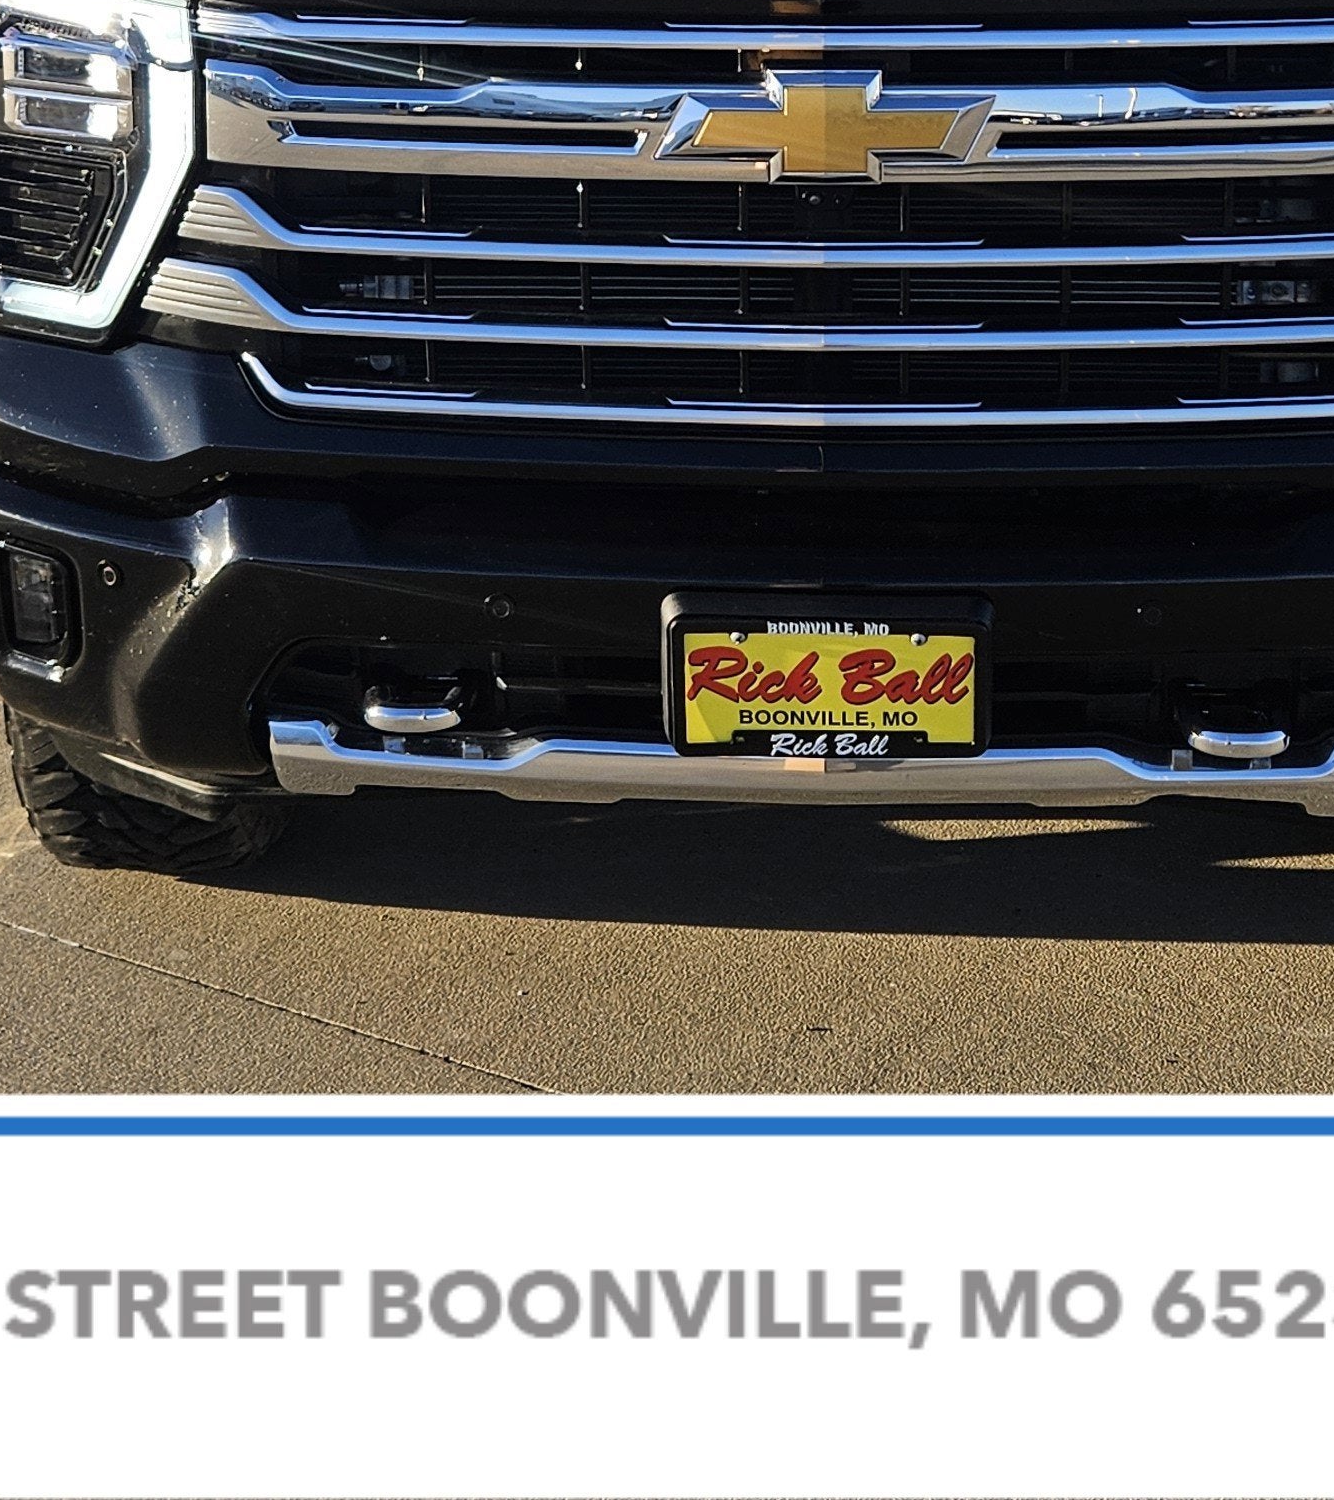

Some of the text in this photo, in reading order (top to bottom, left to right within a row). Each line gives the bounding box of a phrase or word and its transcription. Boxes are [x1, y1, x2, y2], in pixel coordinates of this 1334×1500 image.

[767, 620, 890, 638] BOONVILLE, MO
[687, 646, 974, 705] Rick Ball
[739, 709, 918, 729] BOONVILLE, MO
[770, 733, 889, 756] Rick Ball
